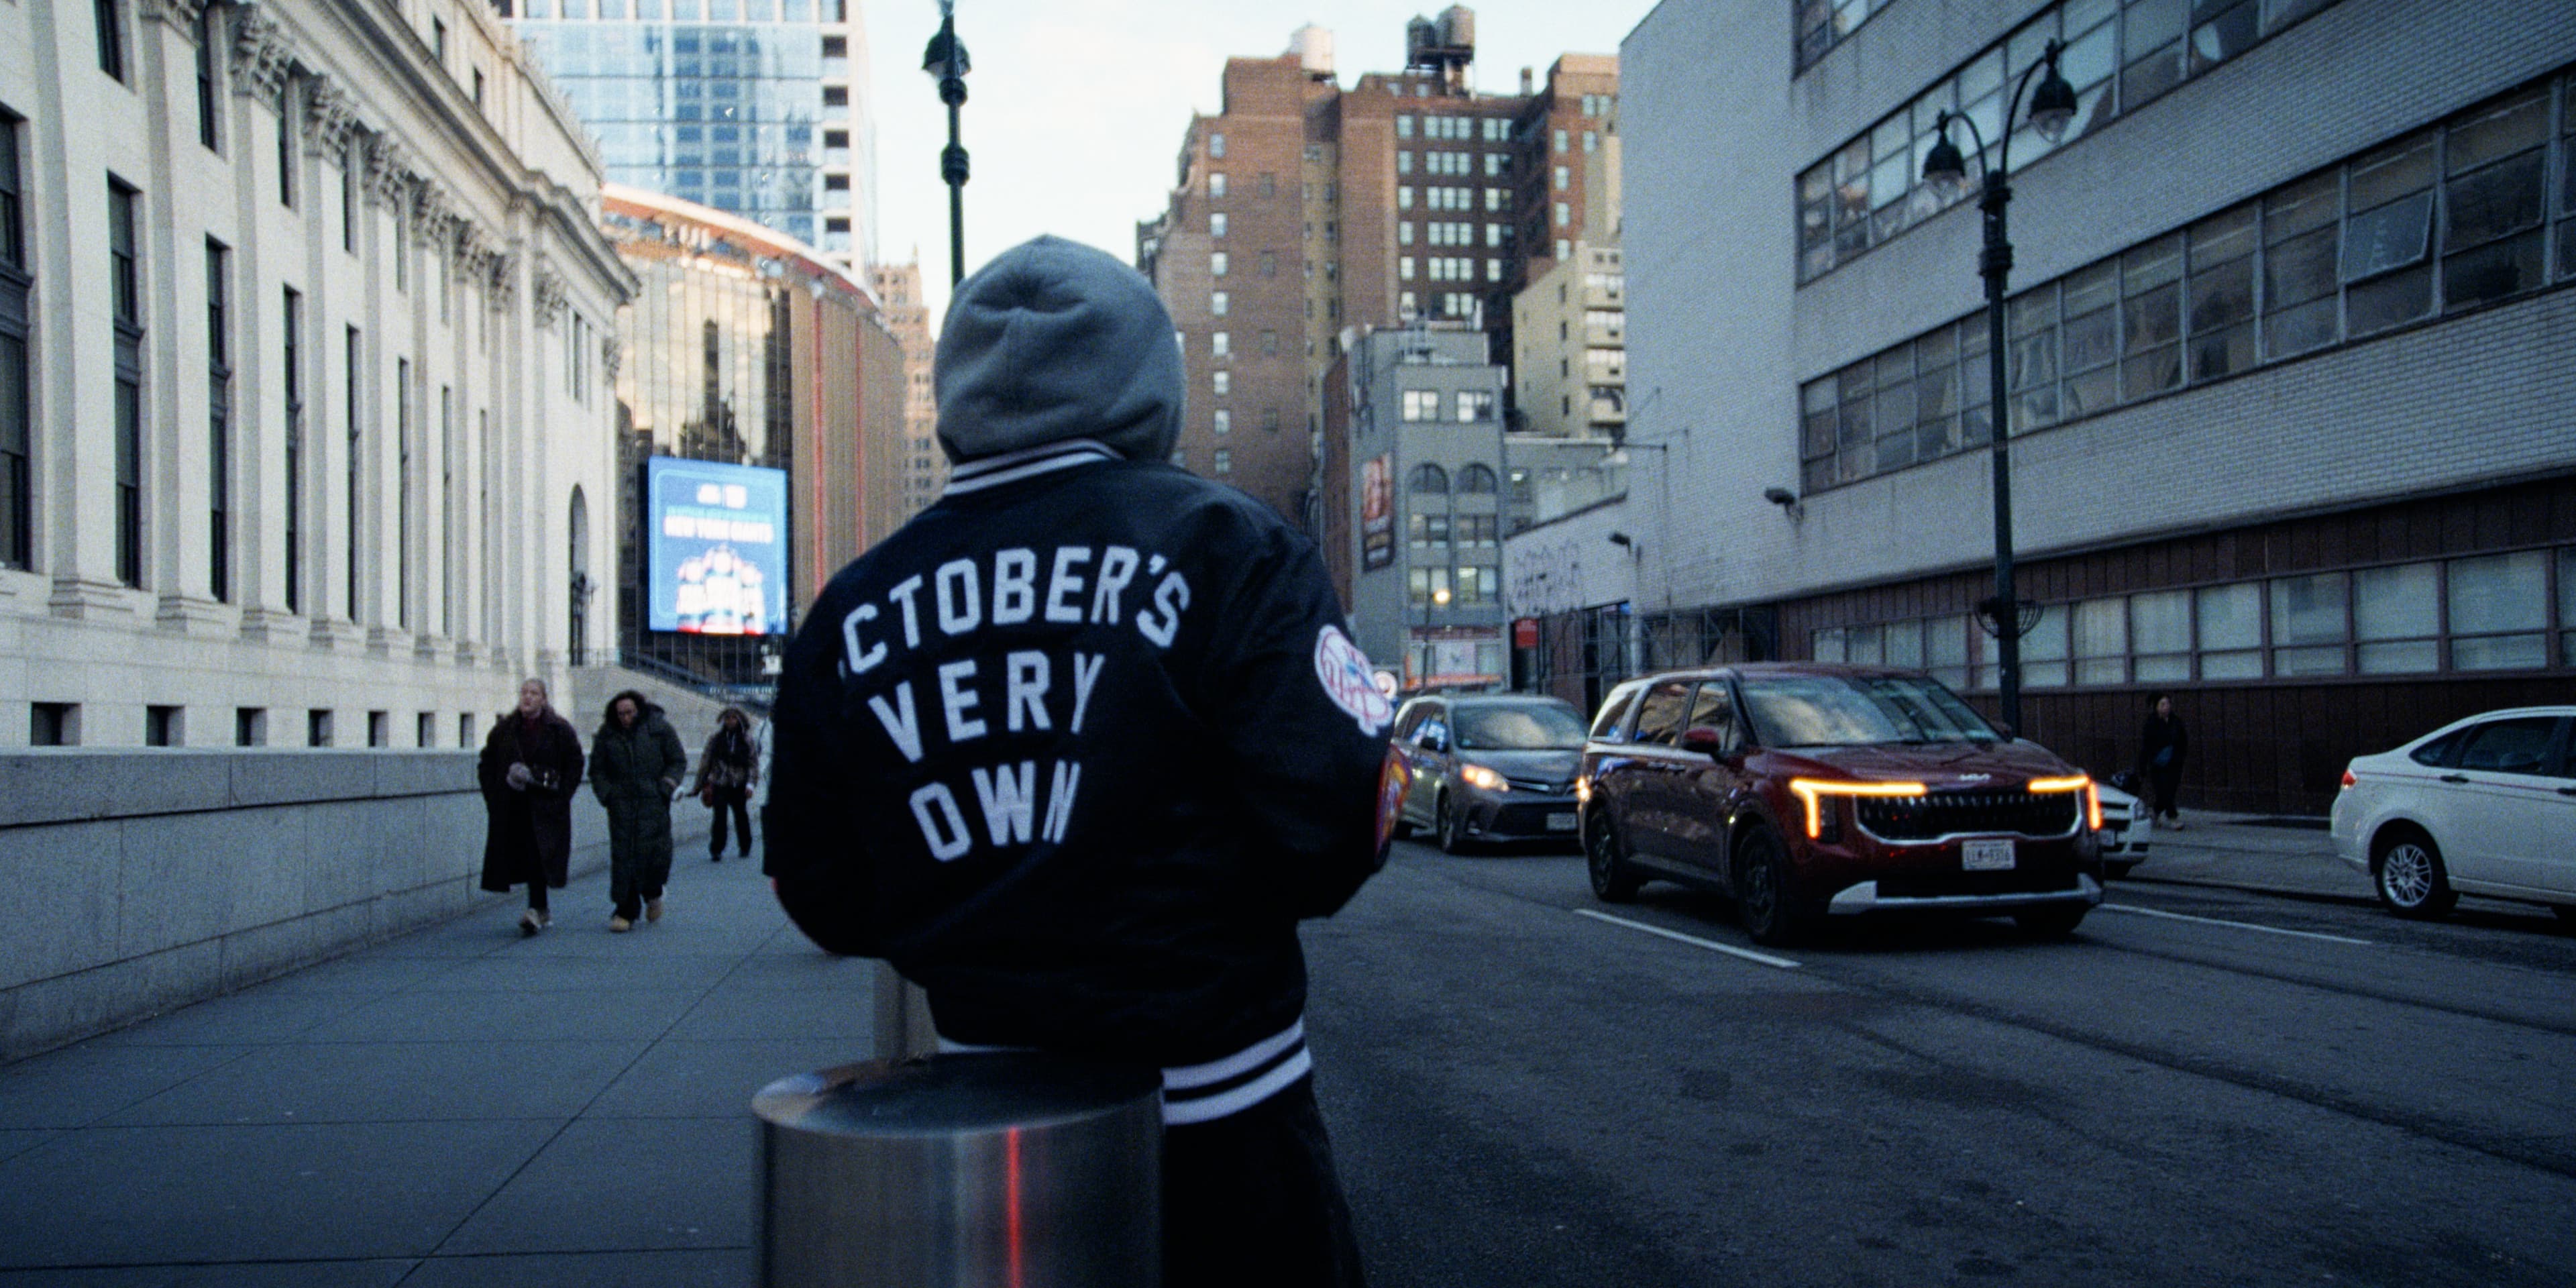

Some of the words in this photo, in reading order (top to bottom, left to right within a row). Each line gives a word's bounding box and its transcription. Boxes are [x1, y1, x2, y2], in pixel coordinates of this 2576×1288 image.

[838, 545, 1191, 678] CTOBER'S
[867, 649, 1105, 764] VERY
[908, 759, 1081, 863] OWN
